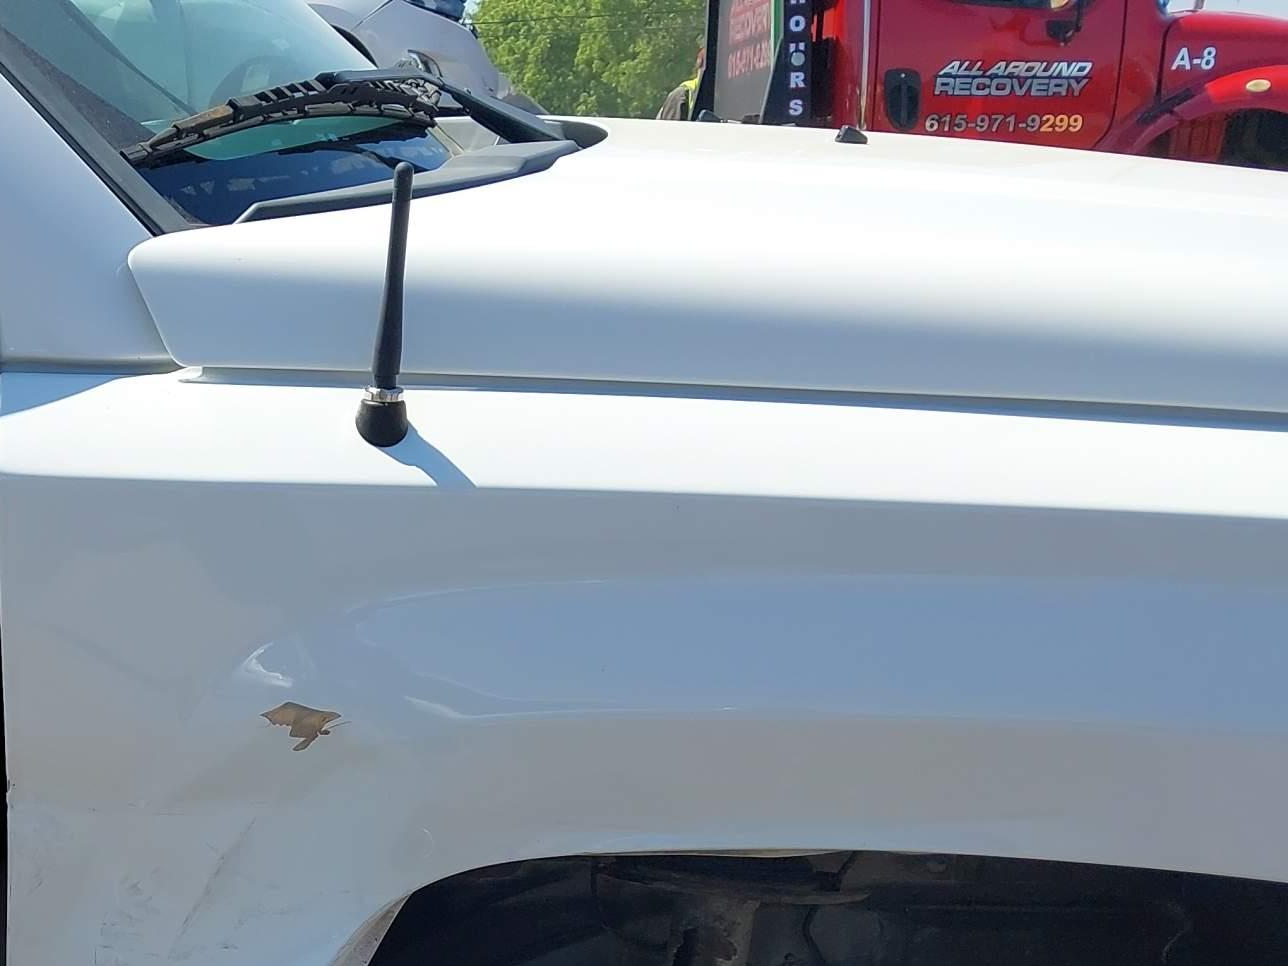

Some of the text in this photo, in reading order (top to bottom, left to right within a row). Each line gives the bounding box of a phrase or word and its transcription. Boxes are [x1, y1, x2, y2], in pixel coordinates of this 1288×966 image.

[789, 0, 806, 116] ORS
[1171, 46, 1217, 71] A-8
[938, 60, 1094, 77] ALL AROUND
[934, 77, 1088, 97] RECOVERY
[925, 114, 1083, 133] 615-971-9299
